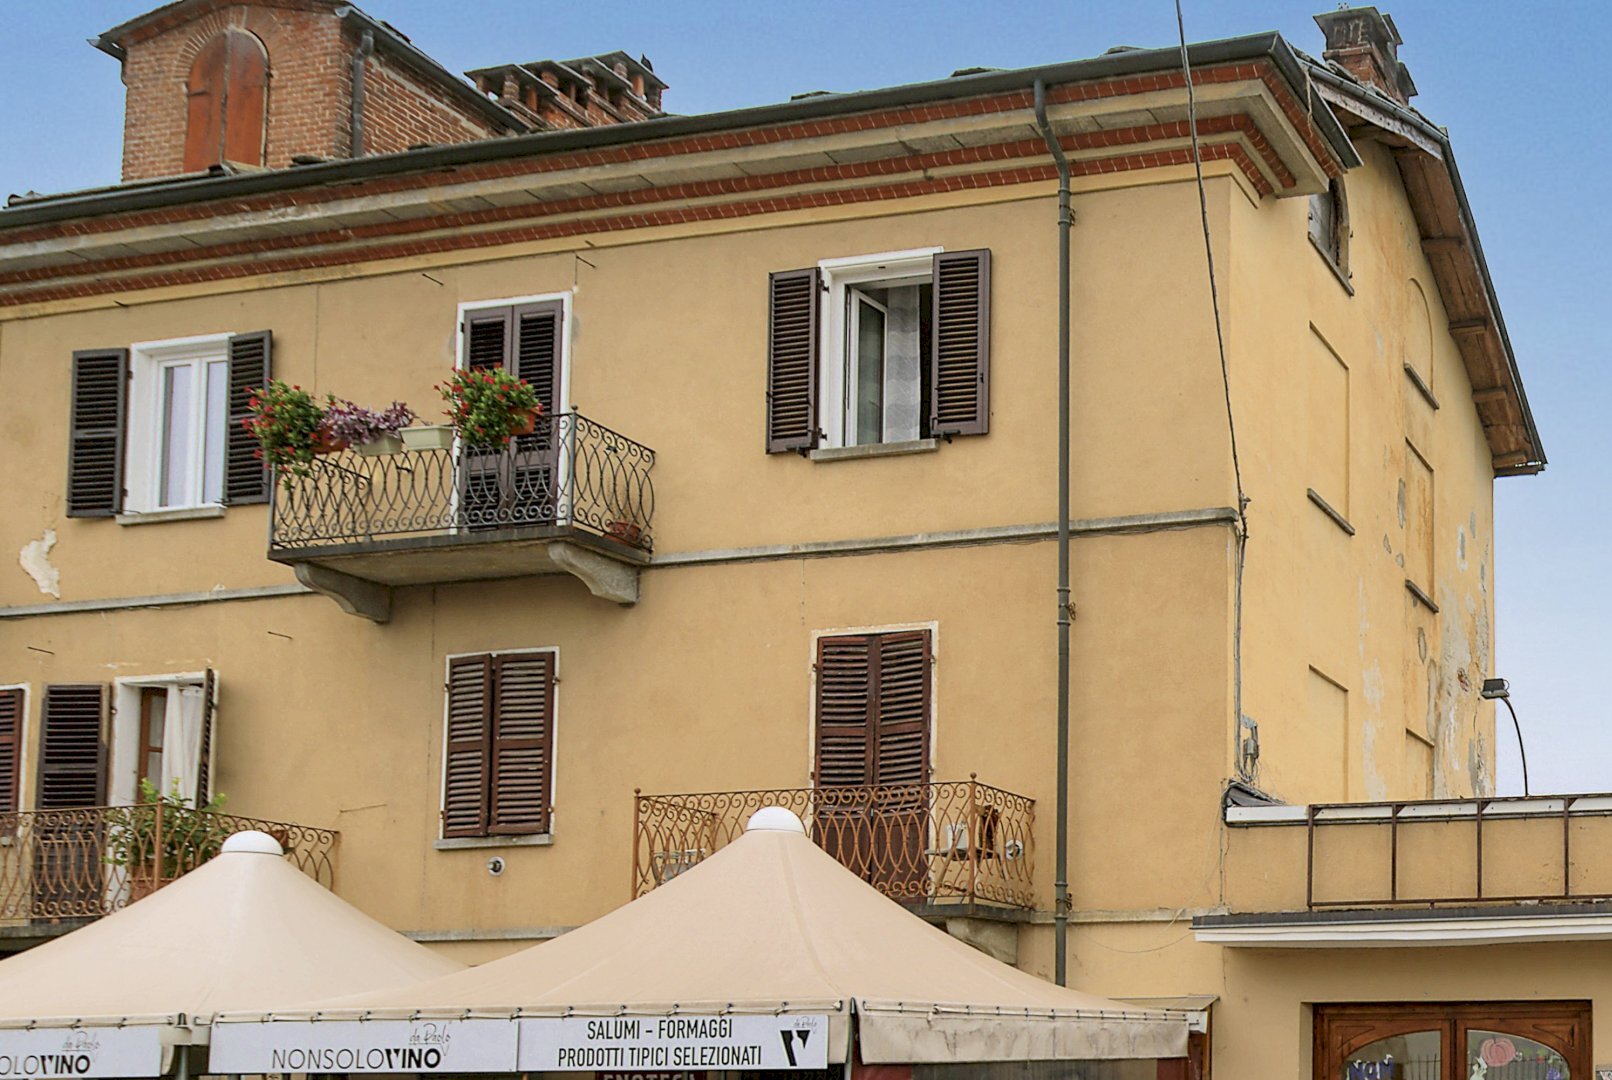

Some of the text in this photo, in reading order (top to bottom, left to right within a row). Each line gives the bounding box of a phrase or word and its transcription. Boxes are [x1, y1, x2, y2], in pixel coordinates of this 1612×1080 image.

[587, 1019, 640, 1040] SALUMI
[658, 1018, 732, 1039] FORMAGGI
[558, 1045, 762, 1067] PRODOTTI TIPICI SELEZIONATI
